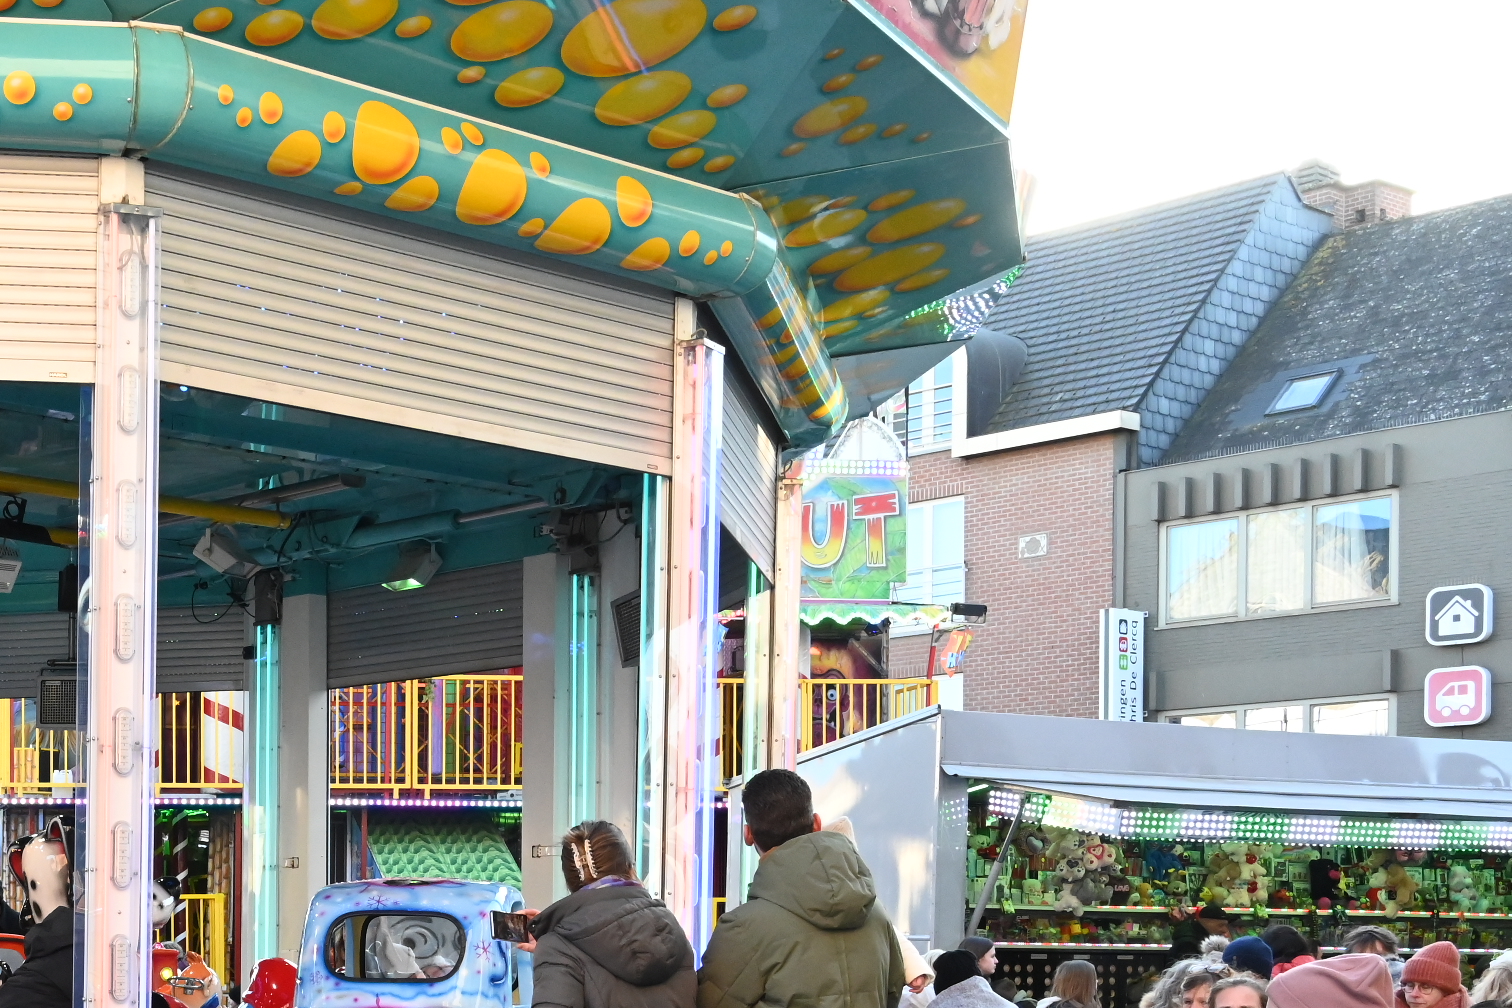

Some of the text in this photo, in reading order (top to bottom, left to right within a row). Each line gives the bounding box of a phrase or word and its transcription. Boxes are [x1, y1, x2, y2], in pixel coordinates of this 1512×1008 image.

[1119, 679, 1128, 721] ingen
[1129, 620, 1139, 722] hris De Clercq
